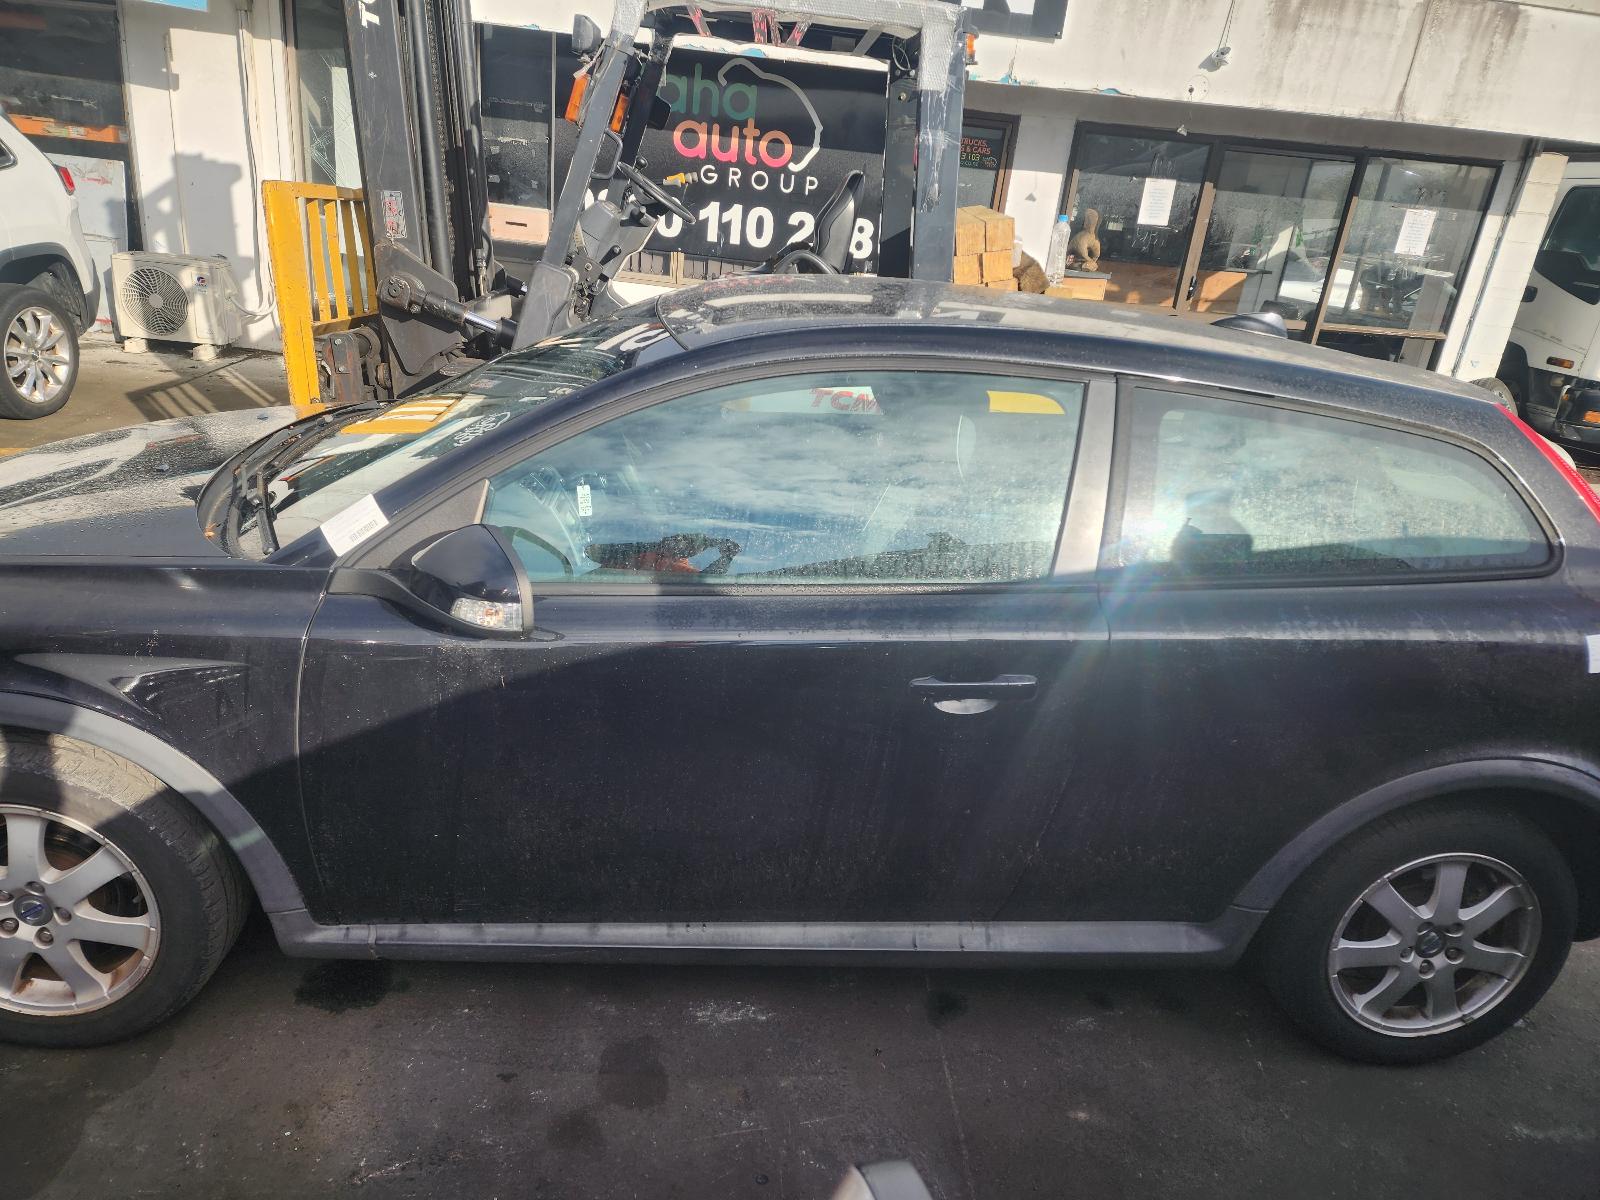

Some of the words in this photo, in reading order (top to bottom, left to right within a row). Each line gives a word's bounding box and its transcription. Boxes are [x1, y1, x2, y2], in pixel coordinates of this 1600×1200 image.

[640, 63, 758, 121] aha
[673, 118, 793, 168] auto
[972, 146, 991, 155] CARS
[700, 164, 819, 196] GROUP
[698, 201, 774, 248] 110
[787, 211, 875, 259] 28
